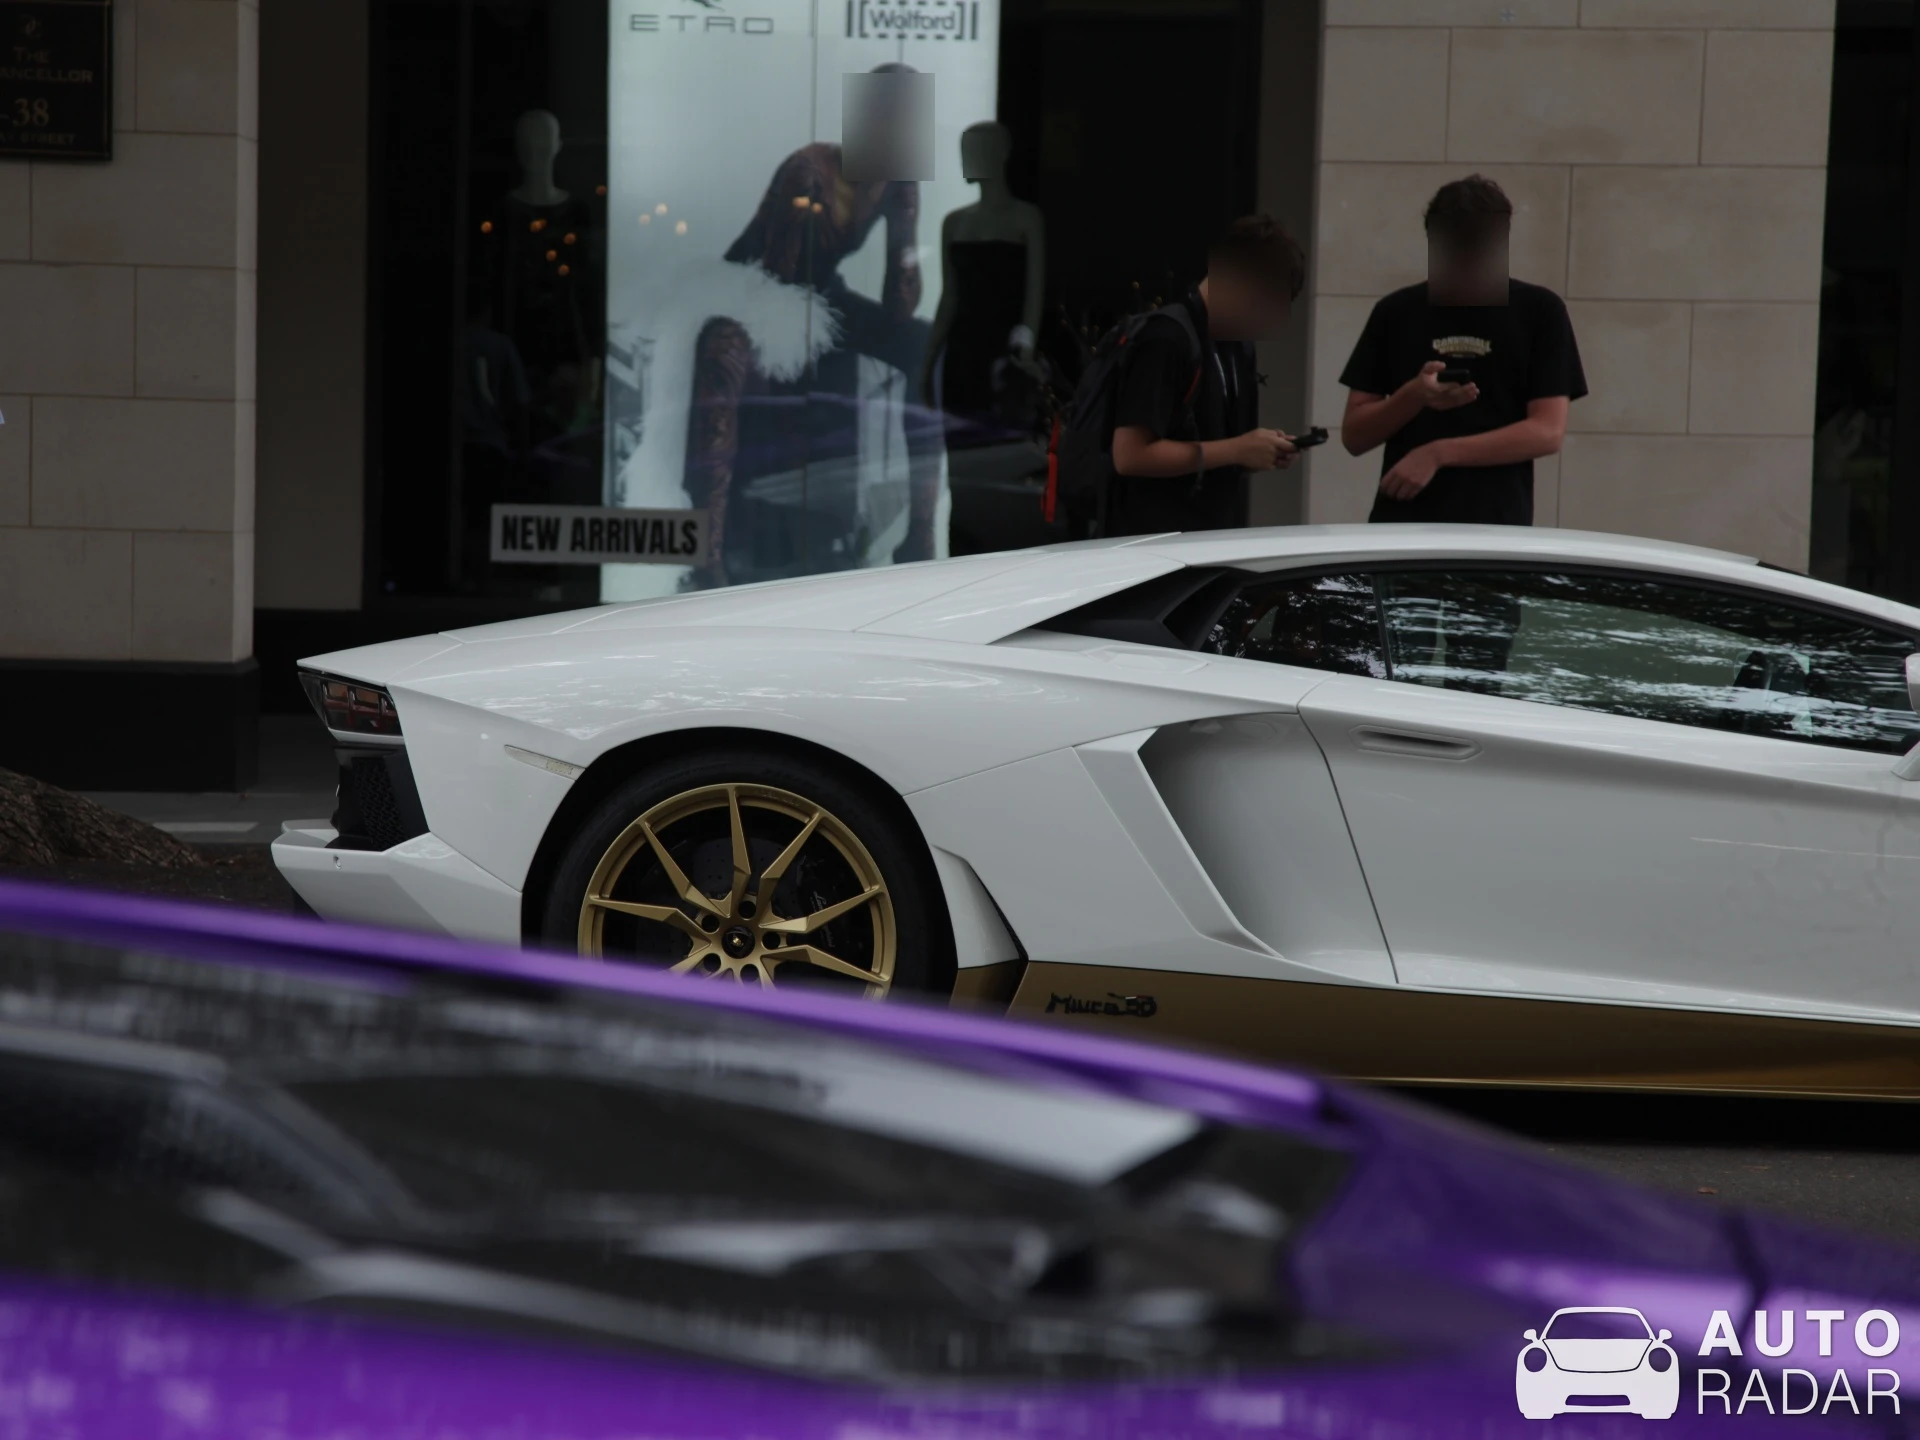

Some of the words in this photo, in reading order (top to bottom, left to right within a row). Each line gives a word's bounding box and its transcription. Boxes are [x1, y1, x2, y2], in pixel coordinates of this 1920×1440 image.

[630, 13, 774, 34] ETRO
[868, 9, 955, 30] Wolford
[14, 47, 50, 63] THE
[502, 515, 560, 551] NEW
[570, 517, 697, 555] ARRIVALS
